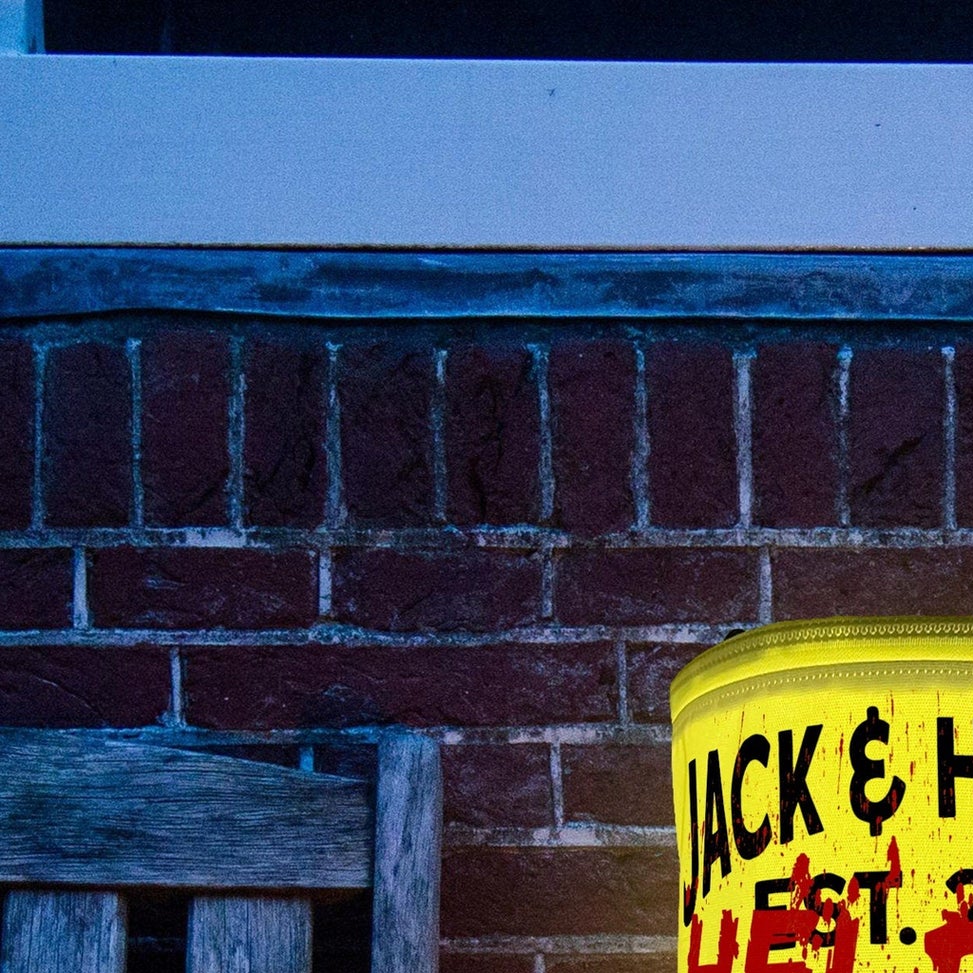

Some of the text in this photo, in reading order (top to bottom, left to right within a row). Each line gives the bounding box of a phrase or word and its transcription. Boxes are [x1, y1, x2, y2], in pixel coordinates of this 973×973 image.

[684, 724, 824, 927] JACK
[849, 706, 906, 836] &
[754, 871, 917, 951] EST.
